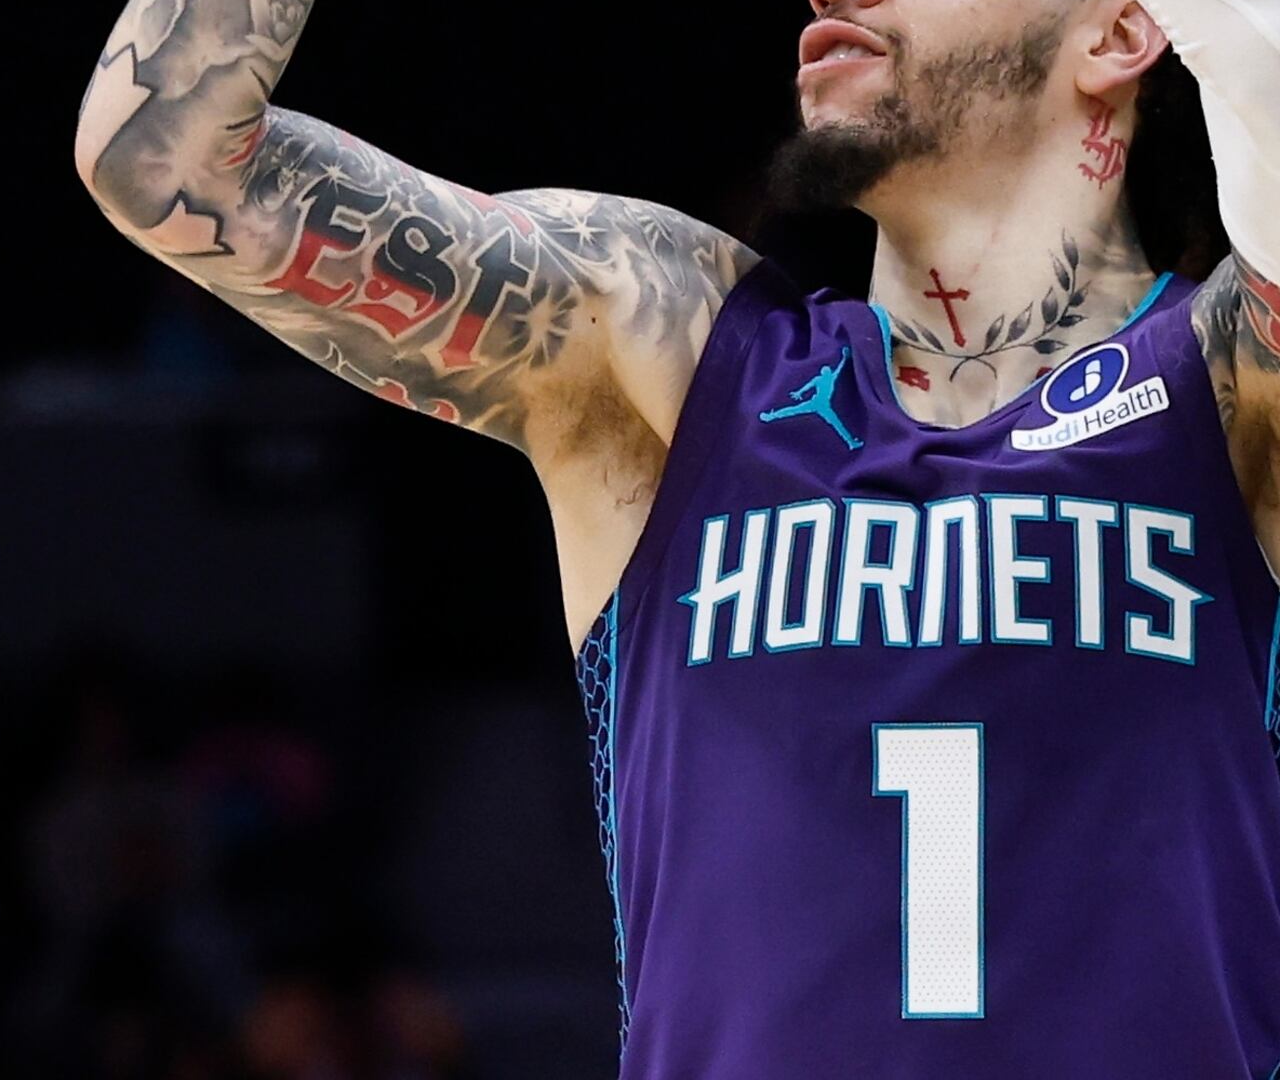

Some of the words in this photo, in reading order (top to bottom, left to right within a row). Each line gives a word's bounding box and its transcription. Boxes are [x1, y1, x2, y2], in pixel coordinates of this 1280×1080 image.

[1083, 385, 1164, 432] Health
[677, 495, 1215, 667] HORNETS
[872, 722, 984, 1019] 1
